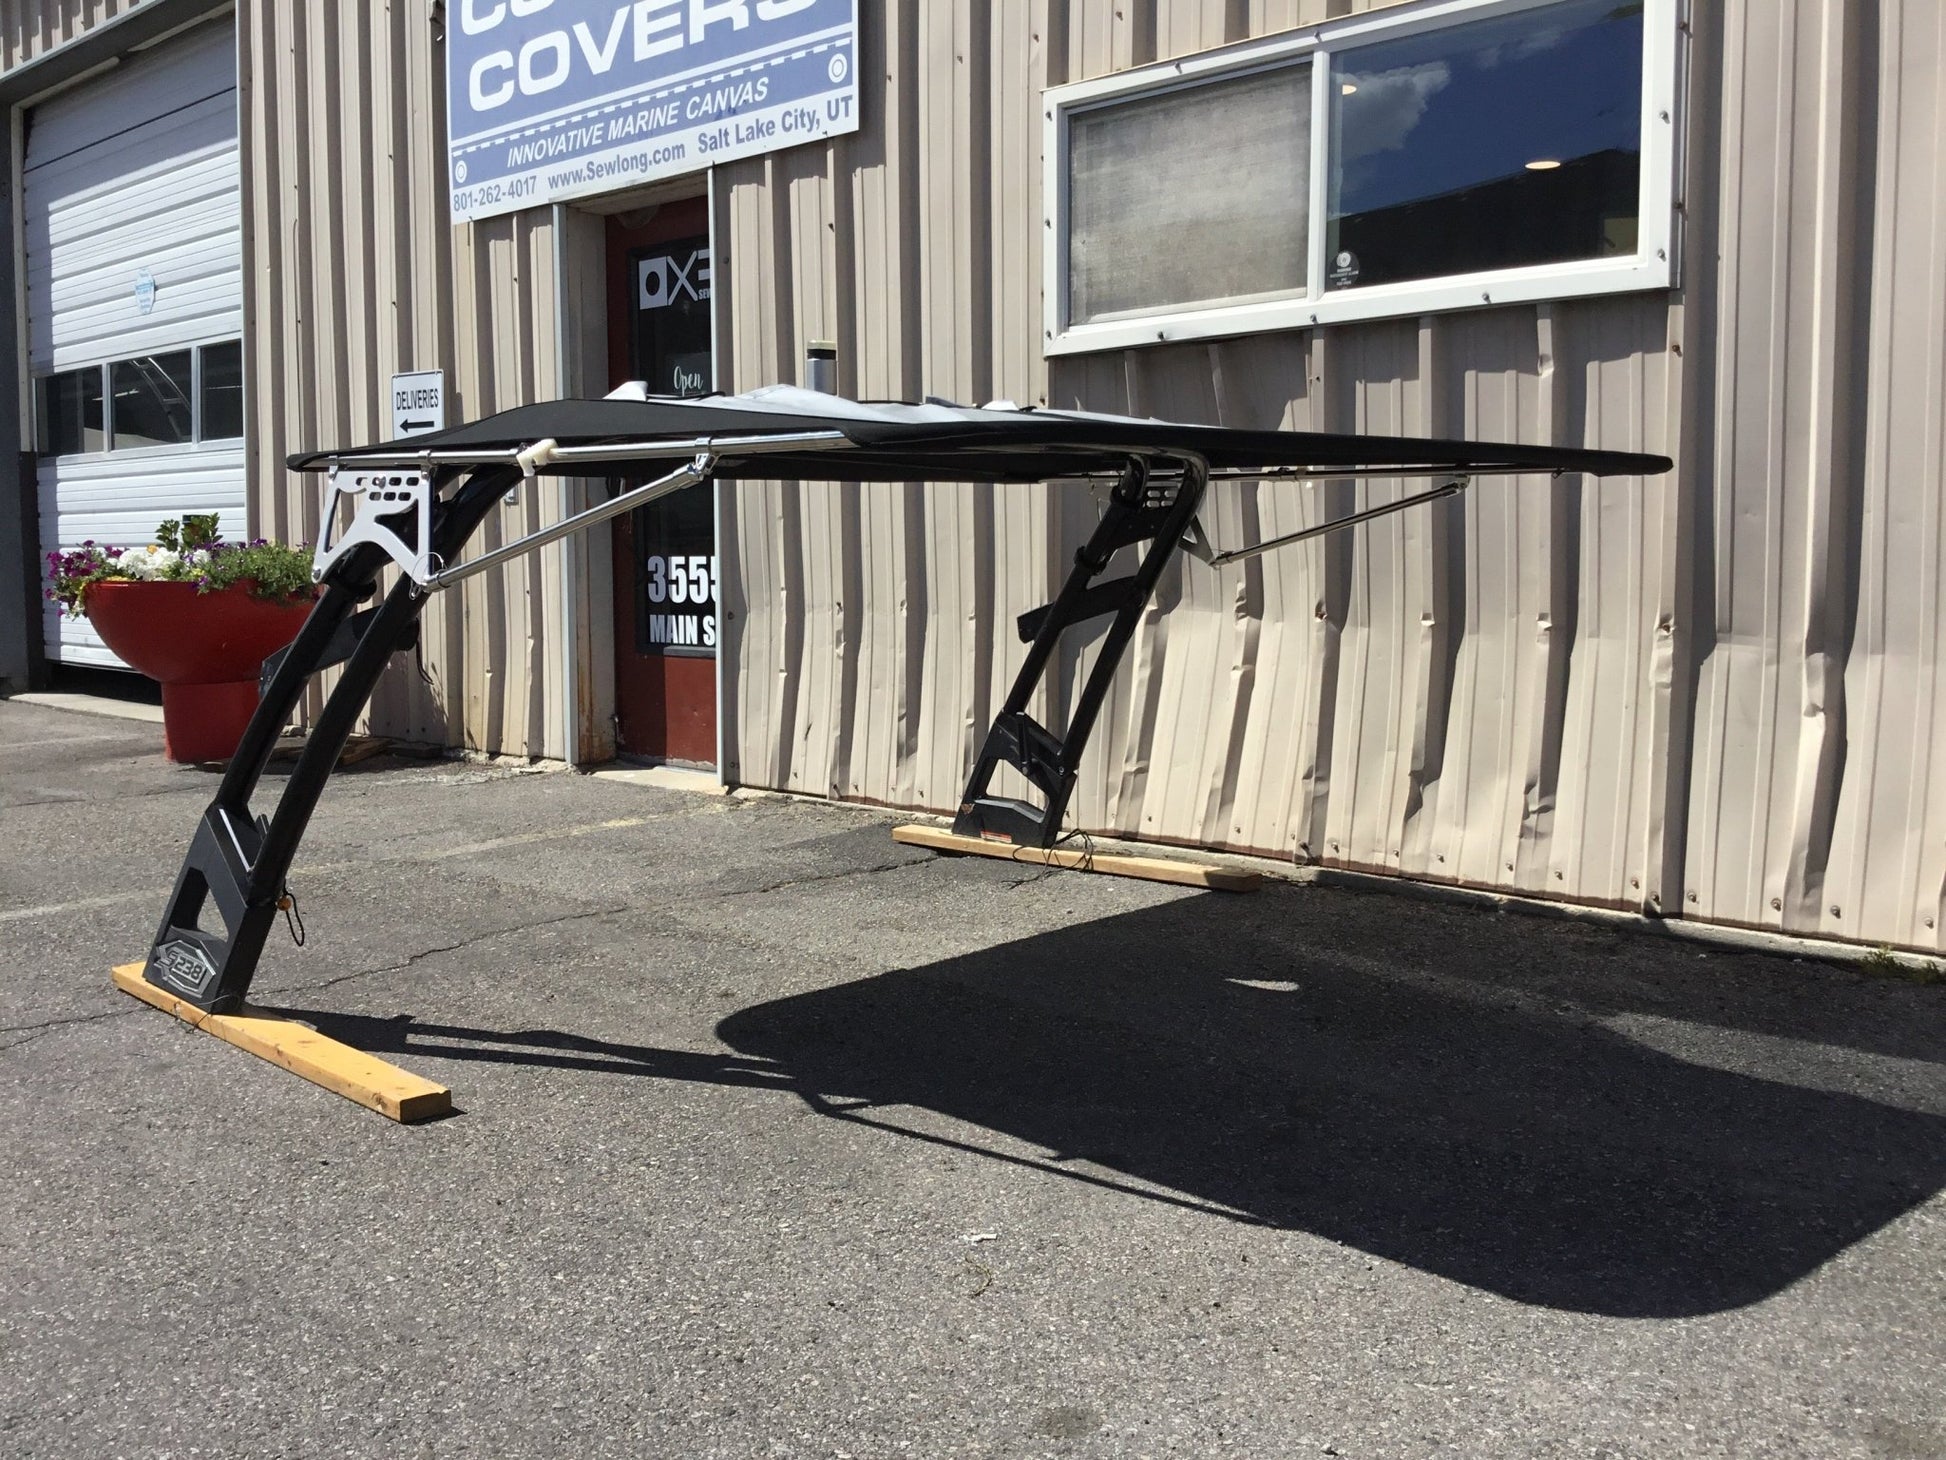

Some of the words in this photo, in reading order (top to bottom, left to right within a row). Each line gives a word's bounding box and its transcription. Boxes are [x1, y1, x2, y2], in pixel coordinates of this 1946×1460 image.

[507, 123, 604, 168] INNOVATIVE
[607, 98, 680, 141] MARINE
[686, 77, 769, 119] CANVAS
[453, 176, 536, 211] 801-262-4017
[548, 149, 686, 189] www.Sewlong.com
[698, 129, 730, 154] Salt
[735, 118, 775, 144] Lake
[781, 108, 820, 134] City,
[827, 95, 853, 121] UT
[674, 365, 704, 396] Open
[396, 388, 439, 410] DELIVERIES
[649, 614, 698, 645] MAIN
